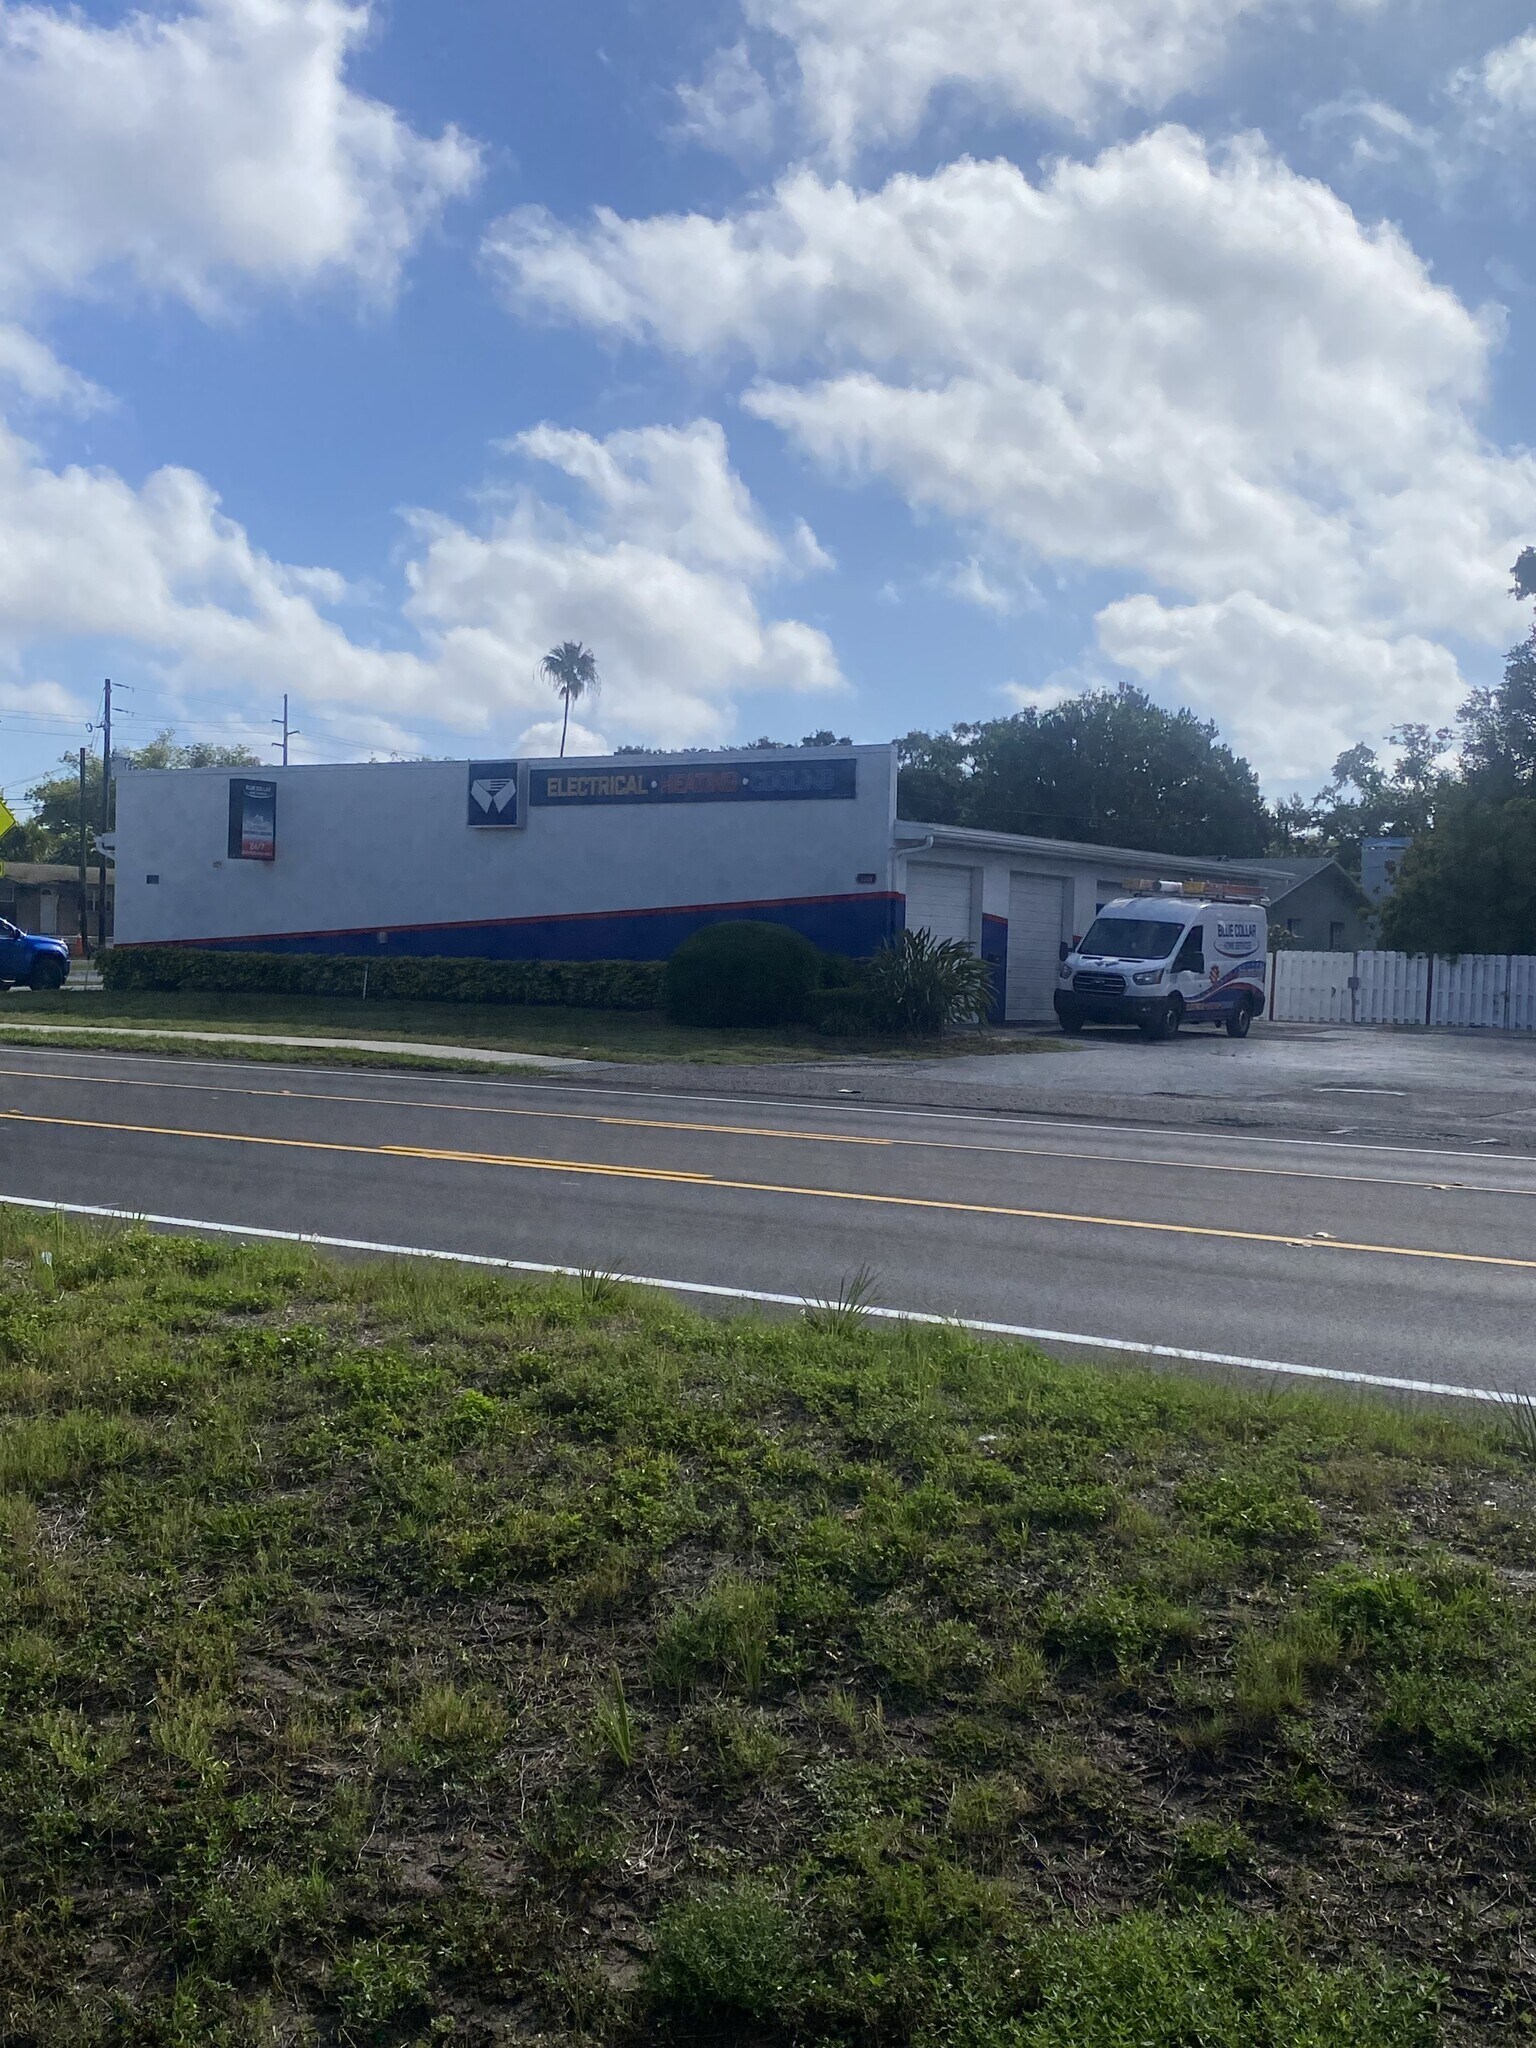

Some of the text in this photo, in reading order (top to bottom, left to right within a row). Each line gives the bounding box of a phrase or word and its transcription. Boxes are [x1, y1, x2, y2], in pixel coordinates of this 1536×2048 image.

[547, 775, 648, 797] ELECTRICAL
[660, 771, 738, 795] HEATING
[1217, 923, 1257, 938] BLUE COLLAR
